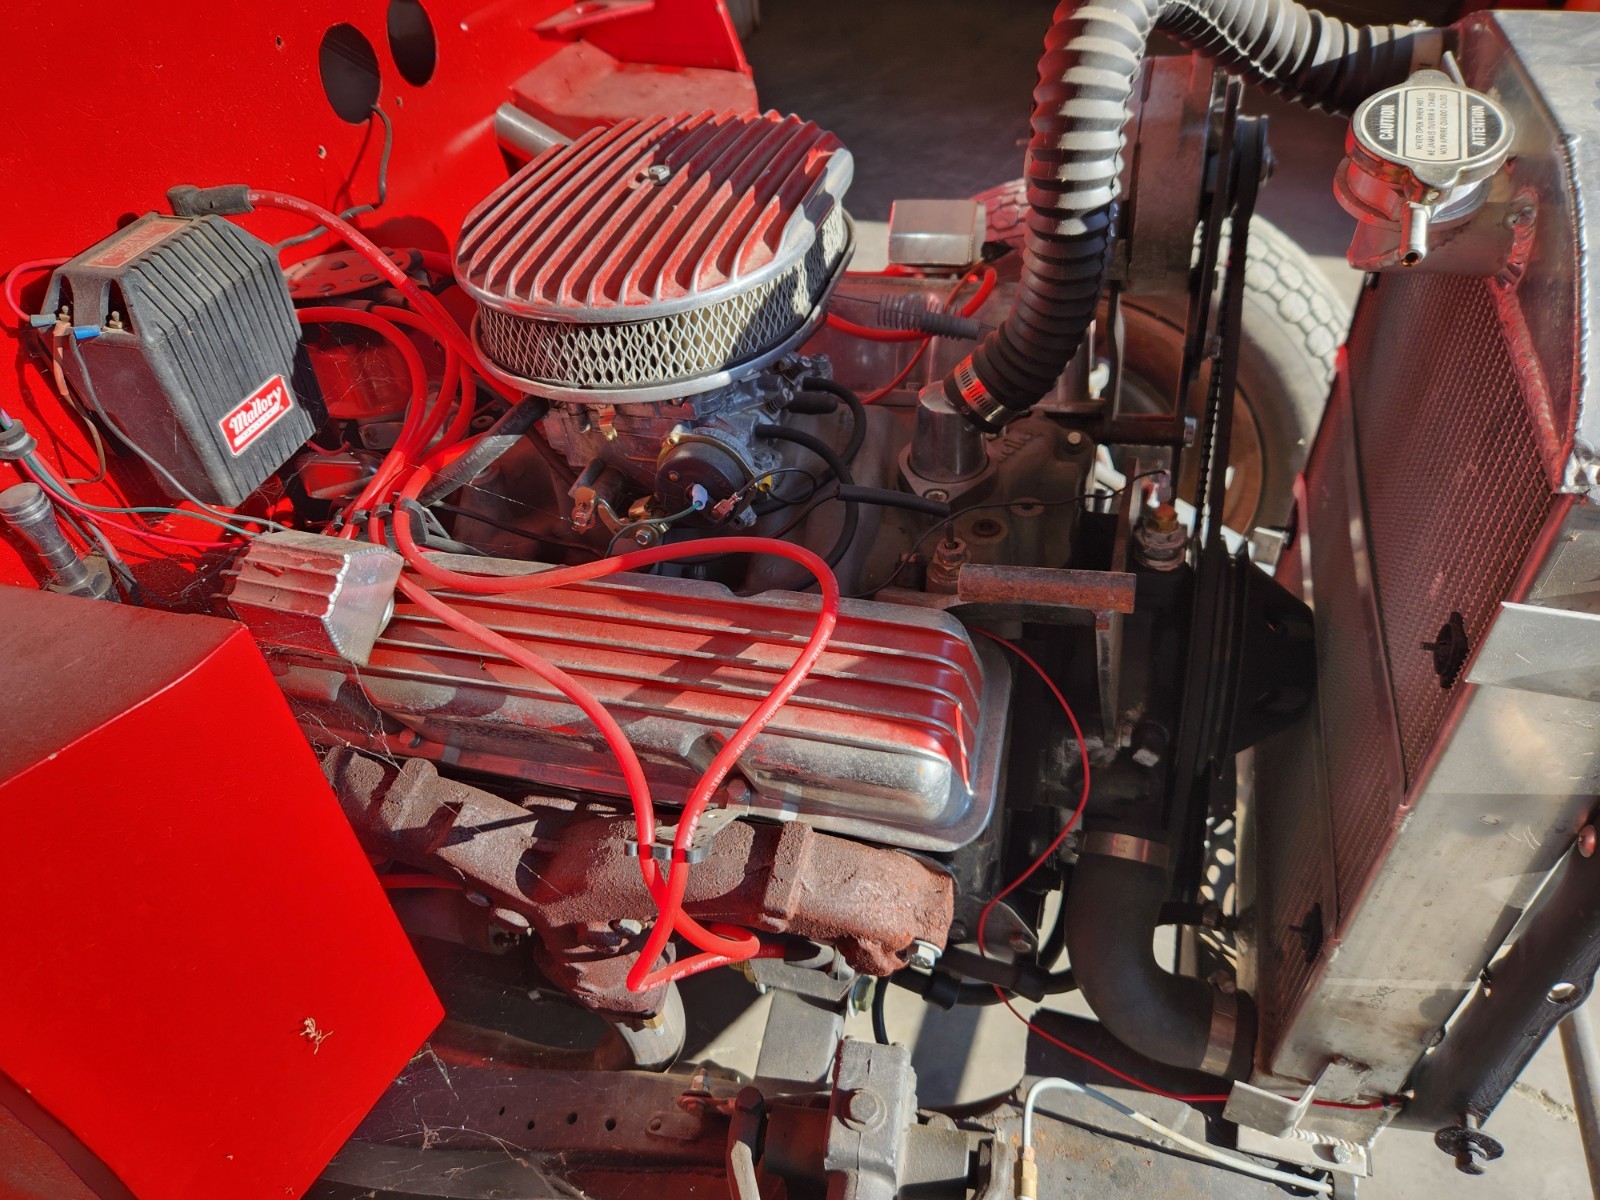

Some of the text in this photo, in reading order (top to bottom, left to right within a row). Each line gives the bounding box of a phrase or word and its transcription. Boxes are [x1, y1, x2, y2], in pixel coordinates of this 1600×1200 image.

[1379, 105, 1395, 140] CAUTION
[1472, 106, 1485, 146] ATTENTION
[275, 197, 308, 210] HI-TEMP
[377, 255, 399, 277] SUPER
[229, 386, 282, 435] Mallory
[703, 766, 729, 801] HI-TEMP
